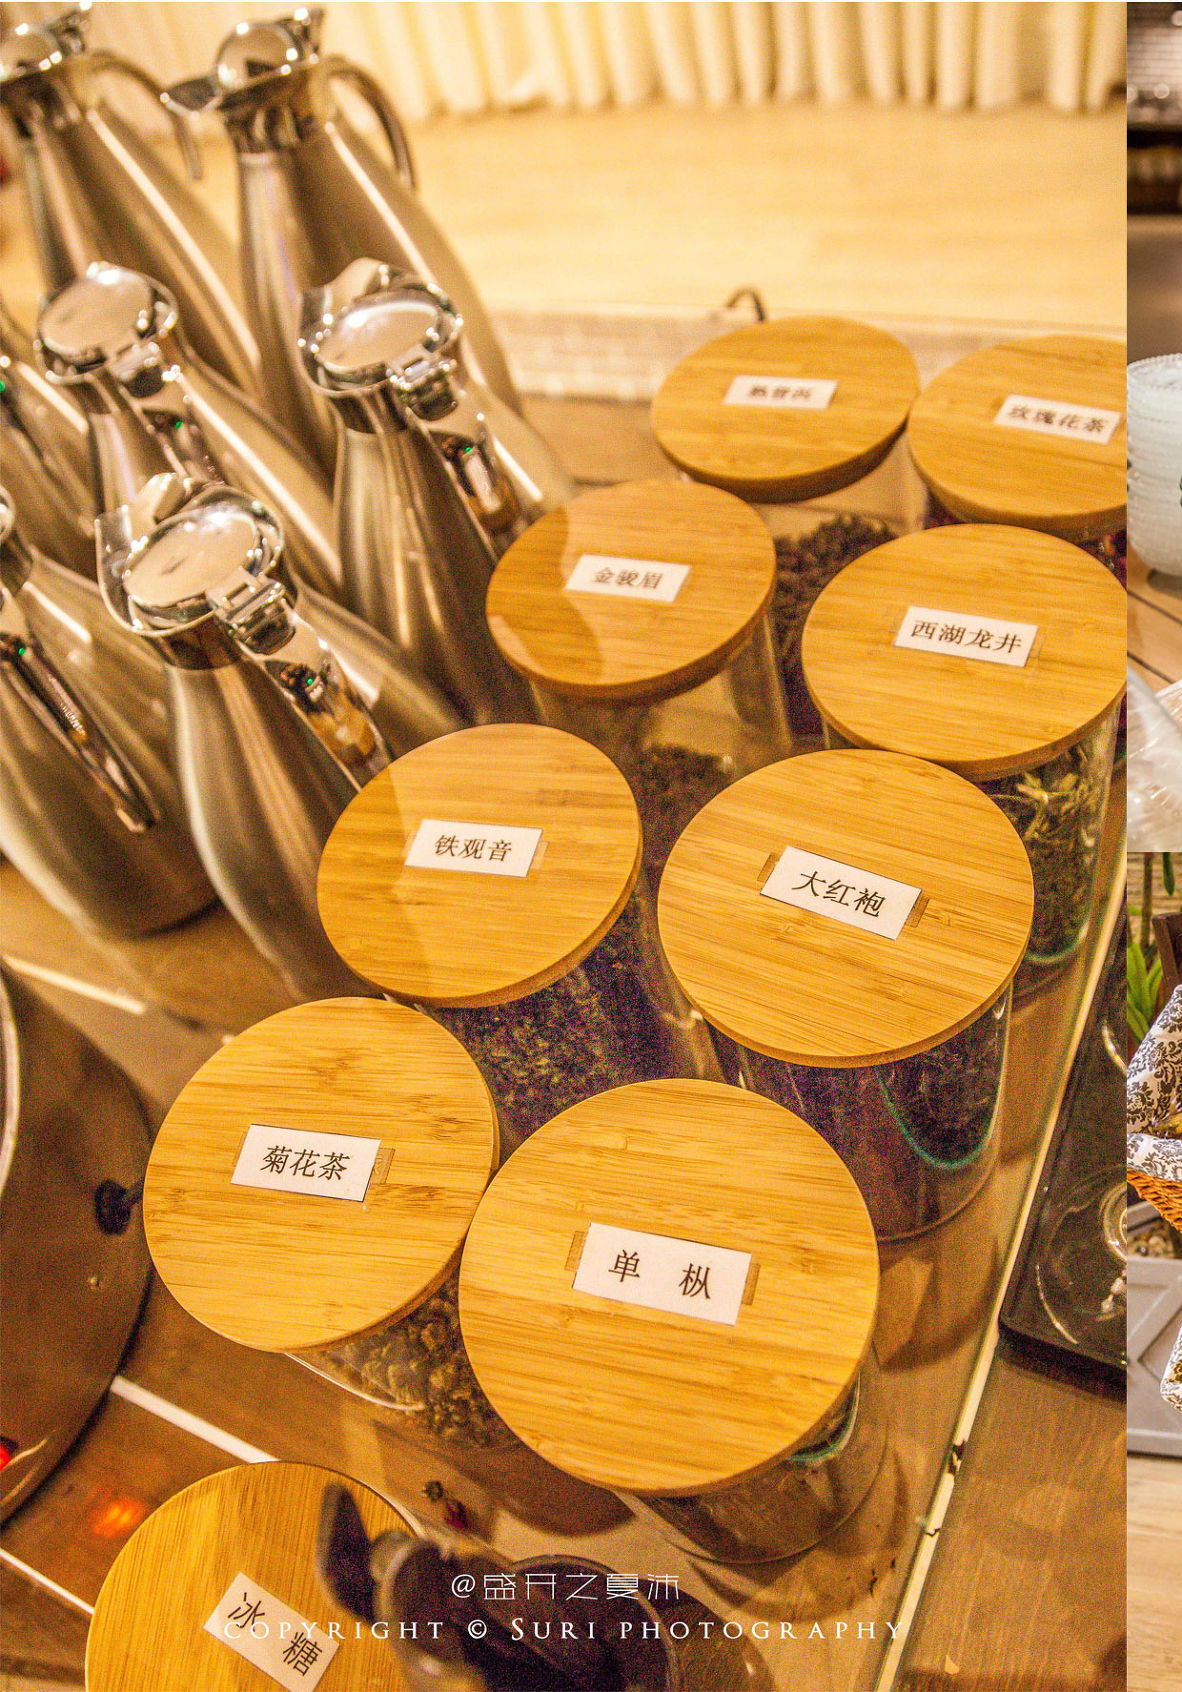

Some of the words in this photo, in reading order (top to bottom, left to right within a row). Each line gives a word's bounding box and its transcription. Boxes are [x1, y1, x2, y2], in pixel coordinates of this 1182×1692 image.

[1007, 404, 1108, 433] 玫瑰花茶
[593, 566, 664, 590] 金骏眉
[910, 619, 1022, 653] 西湖龙井
[434, 833, 513, 863] 铁观音
[792, 870, 888, 918] 大红袍
[260, 1146, 354, 1182] 菊花茶
[608, 1248, 711, 1300] 单枞
[227, 1591, 323, 1677] 冰糖
